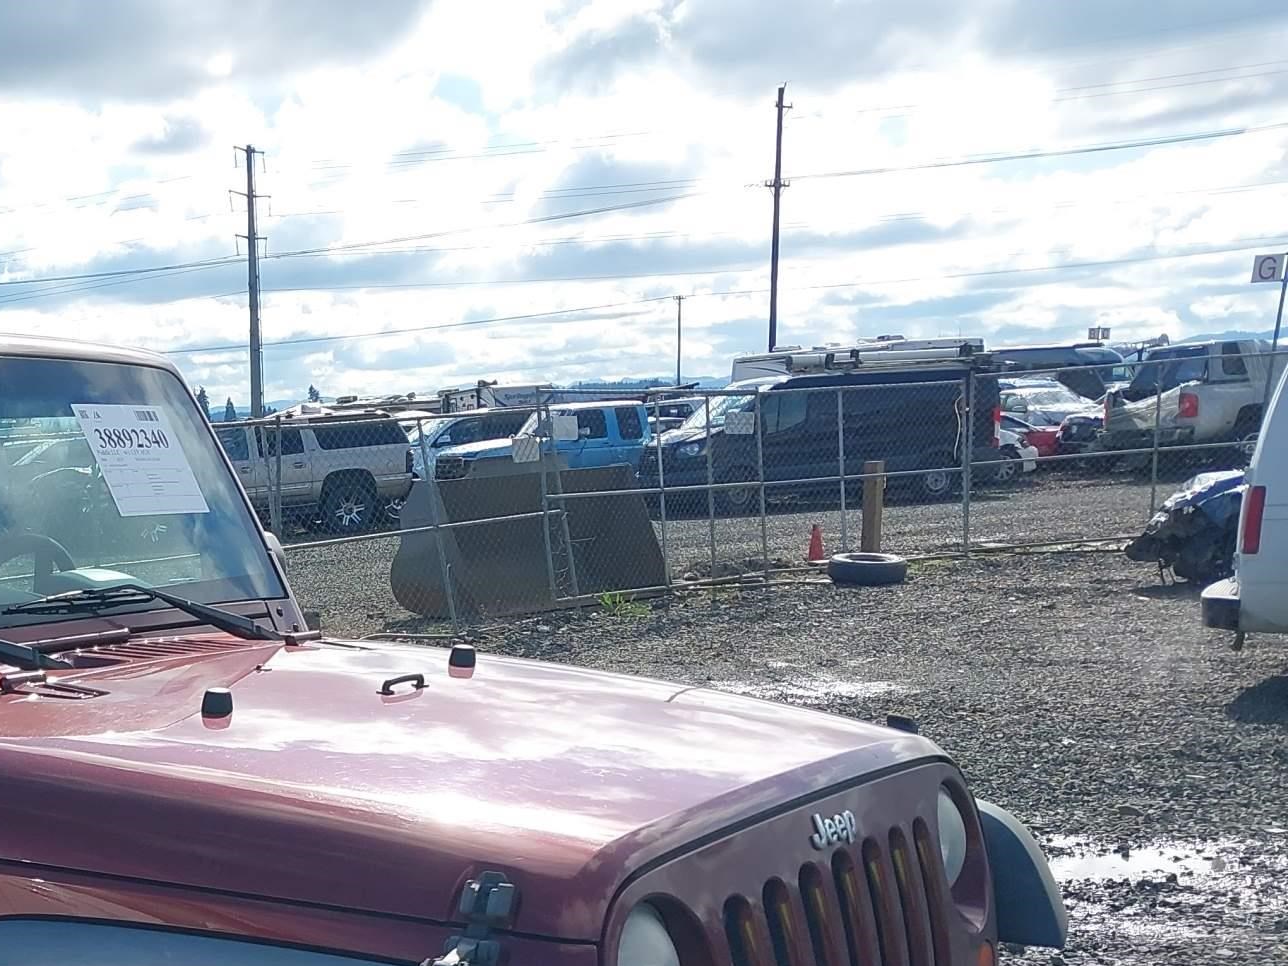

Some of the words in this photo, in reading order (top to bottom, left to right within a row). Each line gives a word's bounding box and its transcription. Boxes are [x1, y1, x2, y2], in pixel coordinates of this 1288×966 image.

[1258, 256, 1278, 280] G
[93, 428, 169, 449] 38892340
[811, 809, 856, 849] Jeep
